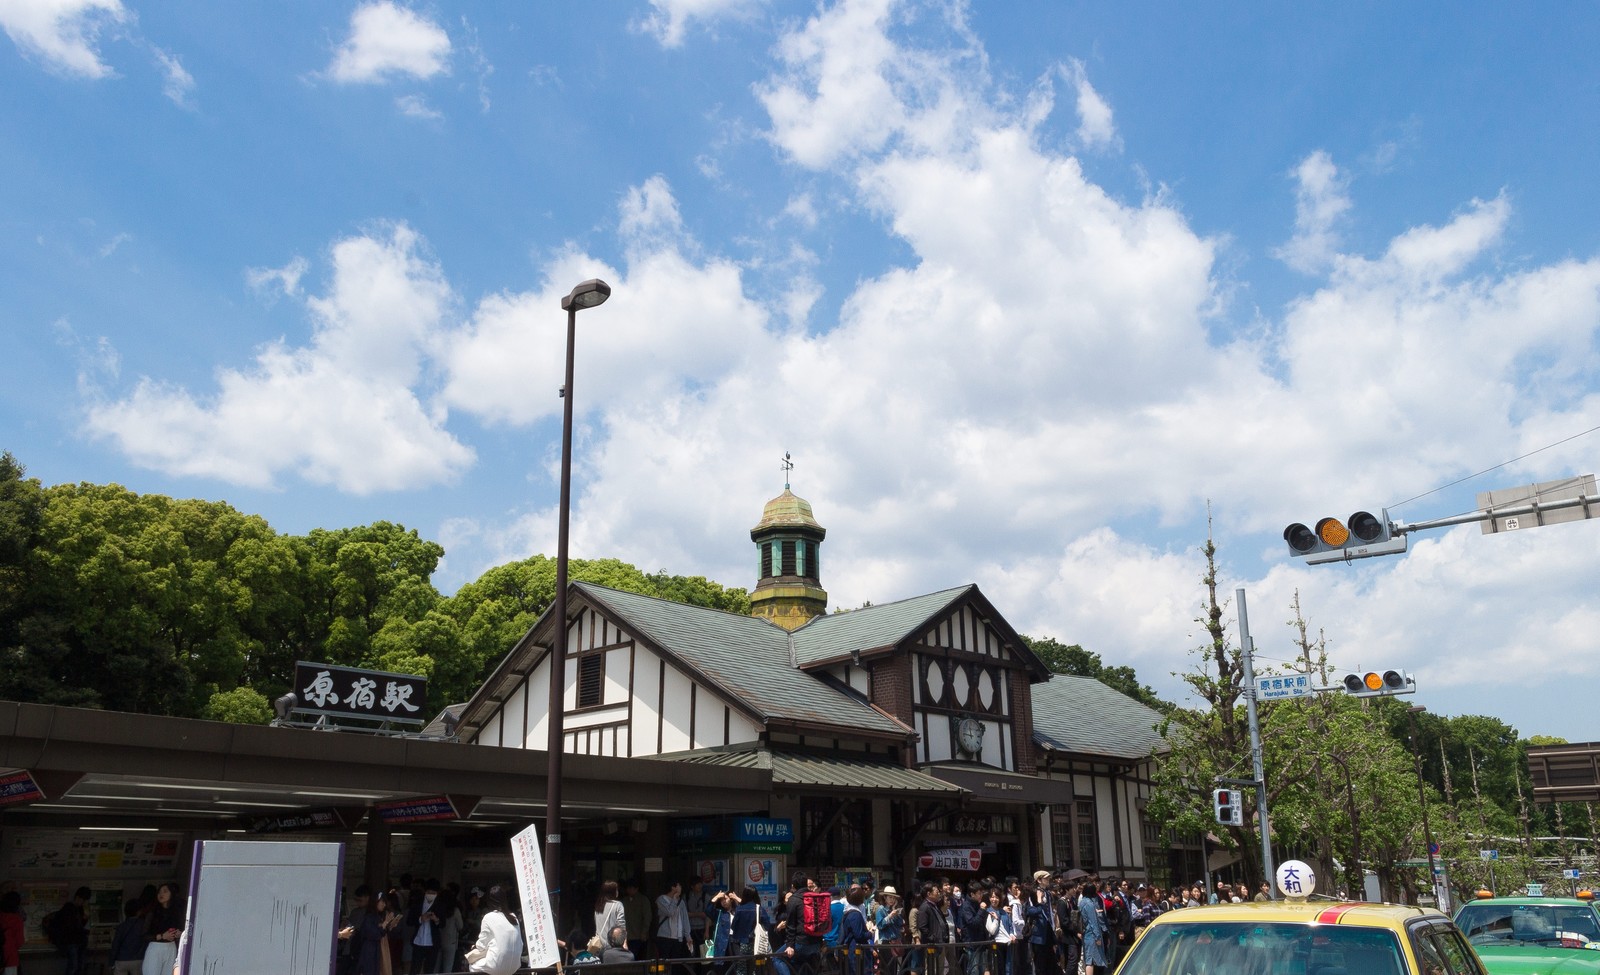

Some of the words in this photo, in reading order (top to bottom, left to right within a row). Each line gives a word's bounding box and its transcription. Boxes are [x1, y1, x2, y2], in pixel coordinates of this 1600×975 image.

[303, 671, 419, 712] 原宿駅
[1260, 676, 1307, 690] 原宿駅前
[935, 856, 968, 869] 出口専用
[1284, 865, 1302, 893] 大和
